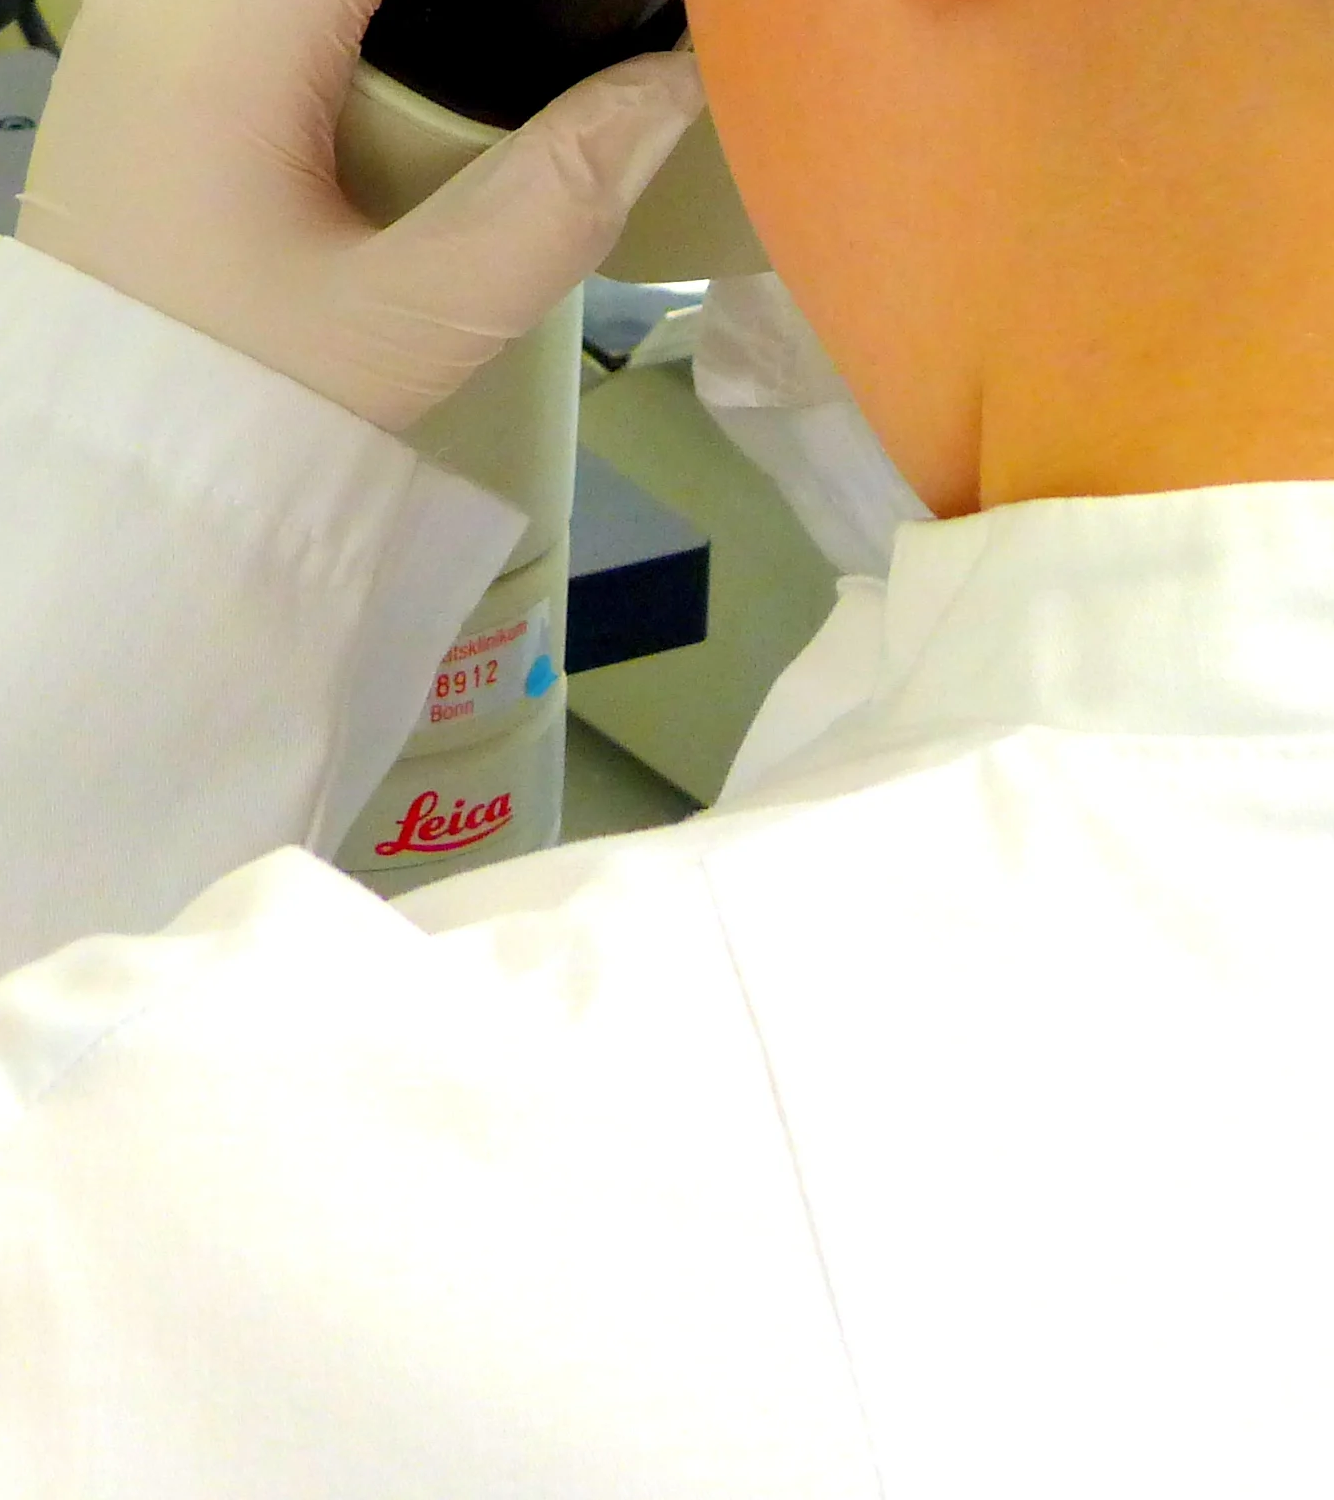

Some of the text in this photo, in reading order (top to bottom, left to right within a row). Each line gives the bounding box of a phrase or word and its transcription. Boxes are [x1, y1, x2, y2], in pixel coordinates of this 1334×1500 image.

[436, 659, 499, 698] 8912
[430, 700, 475, 723] Bonn
[375, 791, 513, 856] Leica
